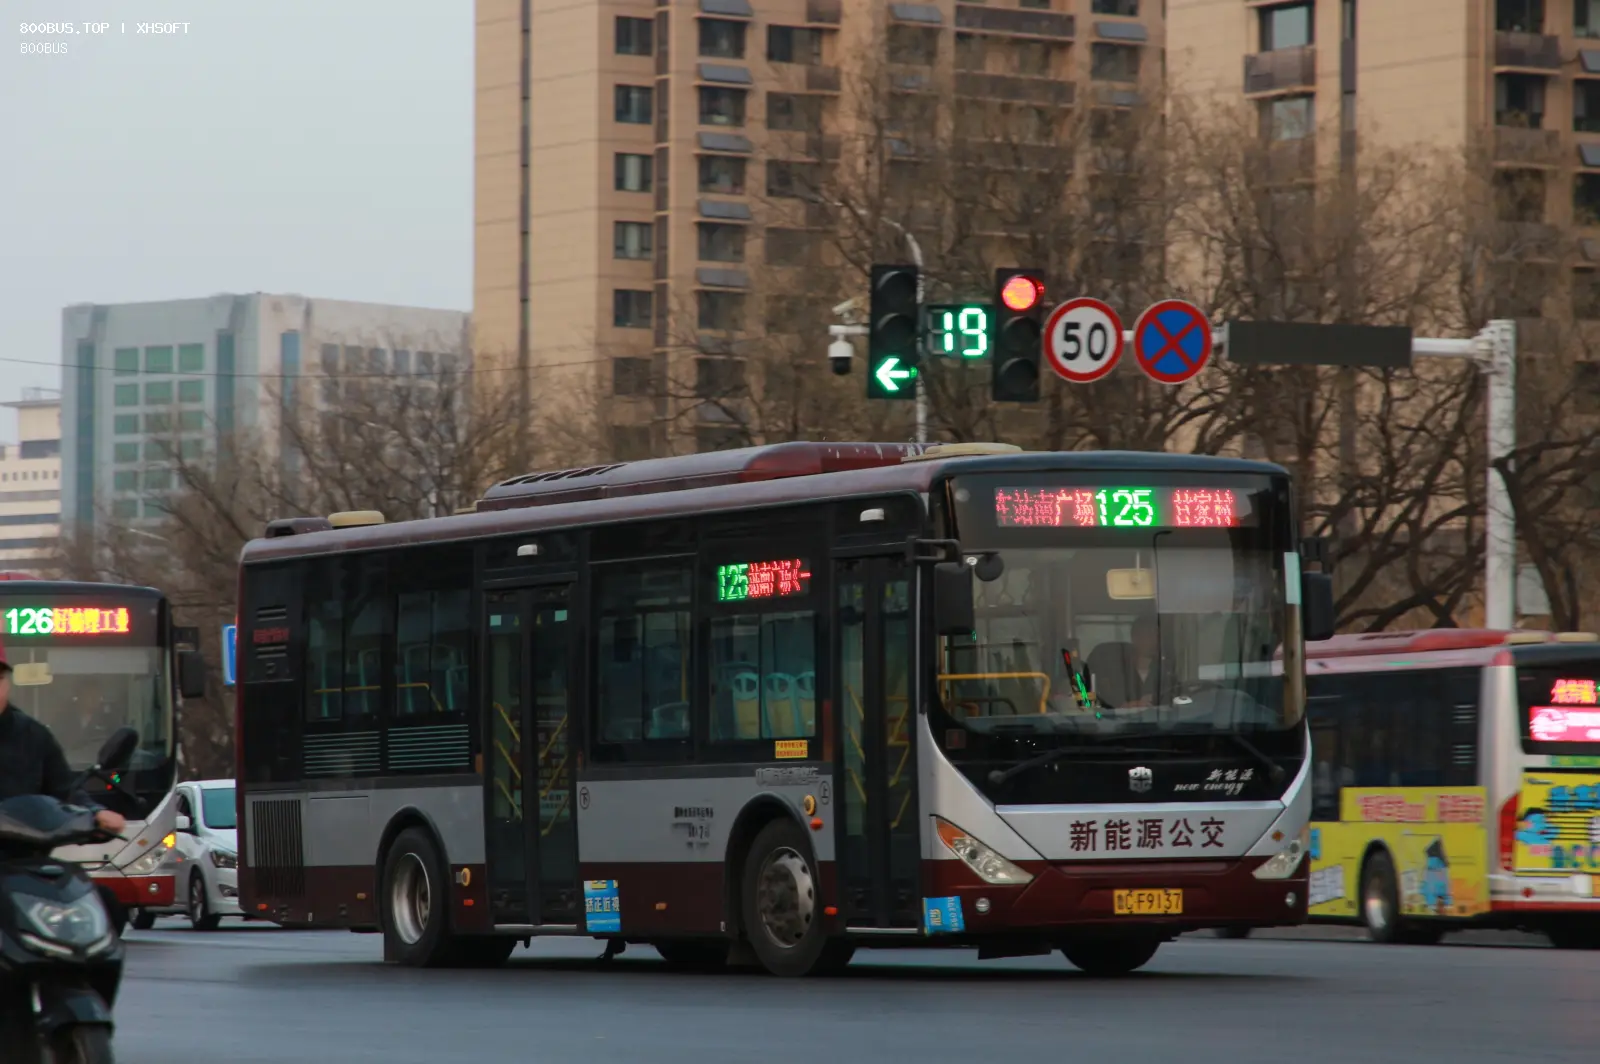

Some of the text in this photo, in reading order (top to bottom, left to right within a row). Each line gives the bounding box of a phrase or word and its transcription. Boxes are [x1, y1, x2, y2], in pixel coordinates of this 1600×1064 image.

[943, 308, 987, 356] 19
[1062, 322, 1107, 361] 50
[1096, 489, 1154, 526] 125
[719, 563, 748, 600] 125
[6, 608, 54, 634] 126
[1174, 782, 1244, 796] new energy
[1070, 817, 1225, 852] 新能源公交
